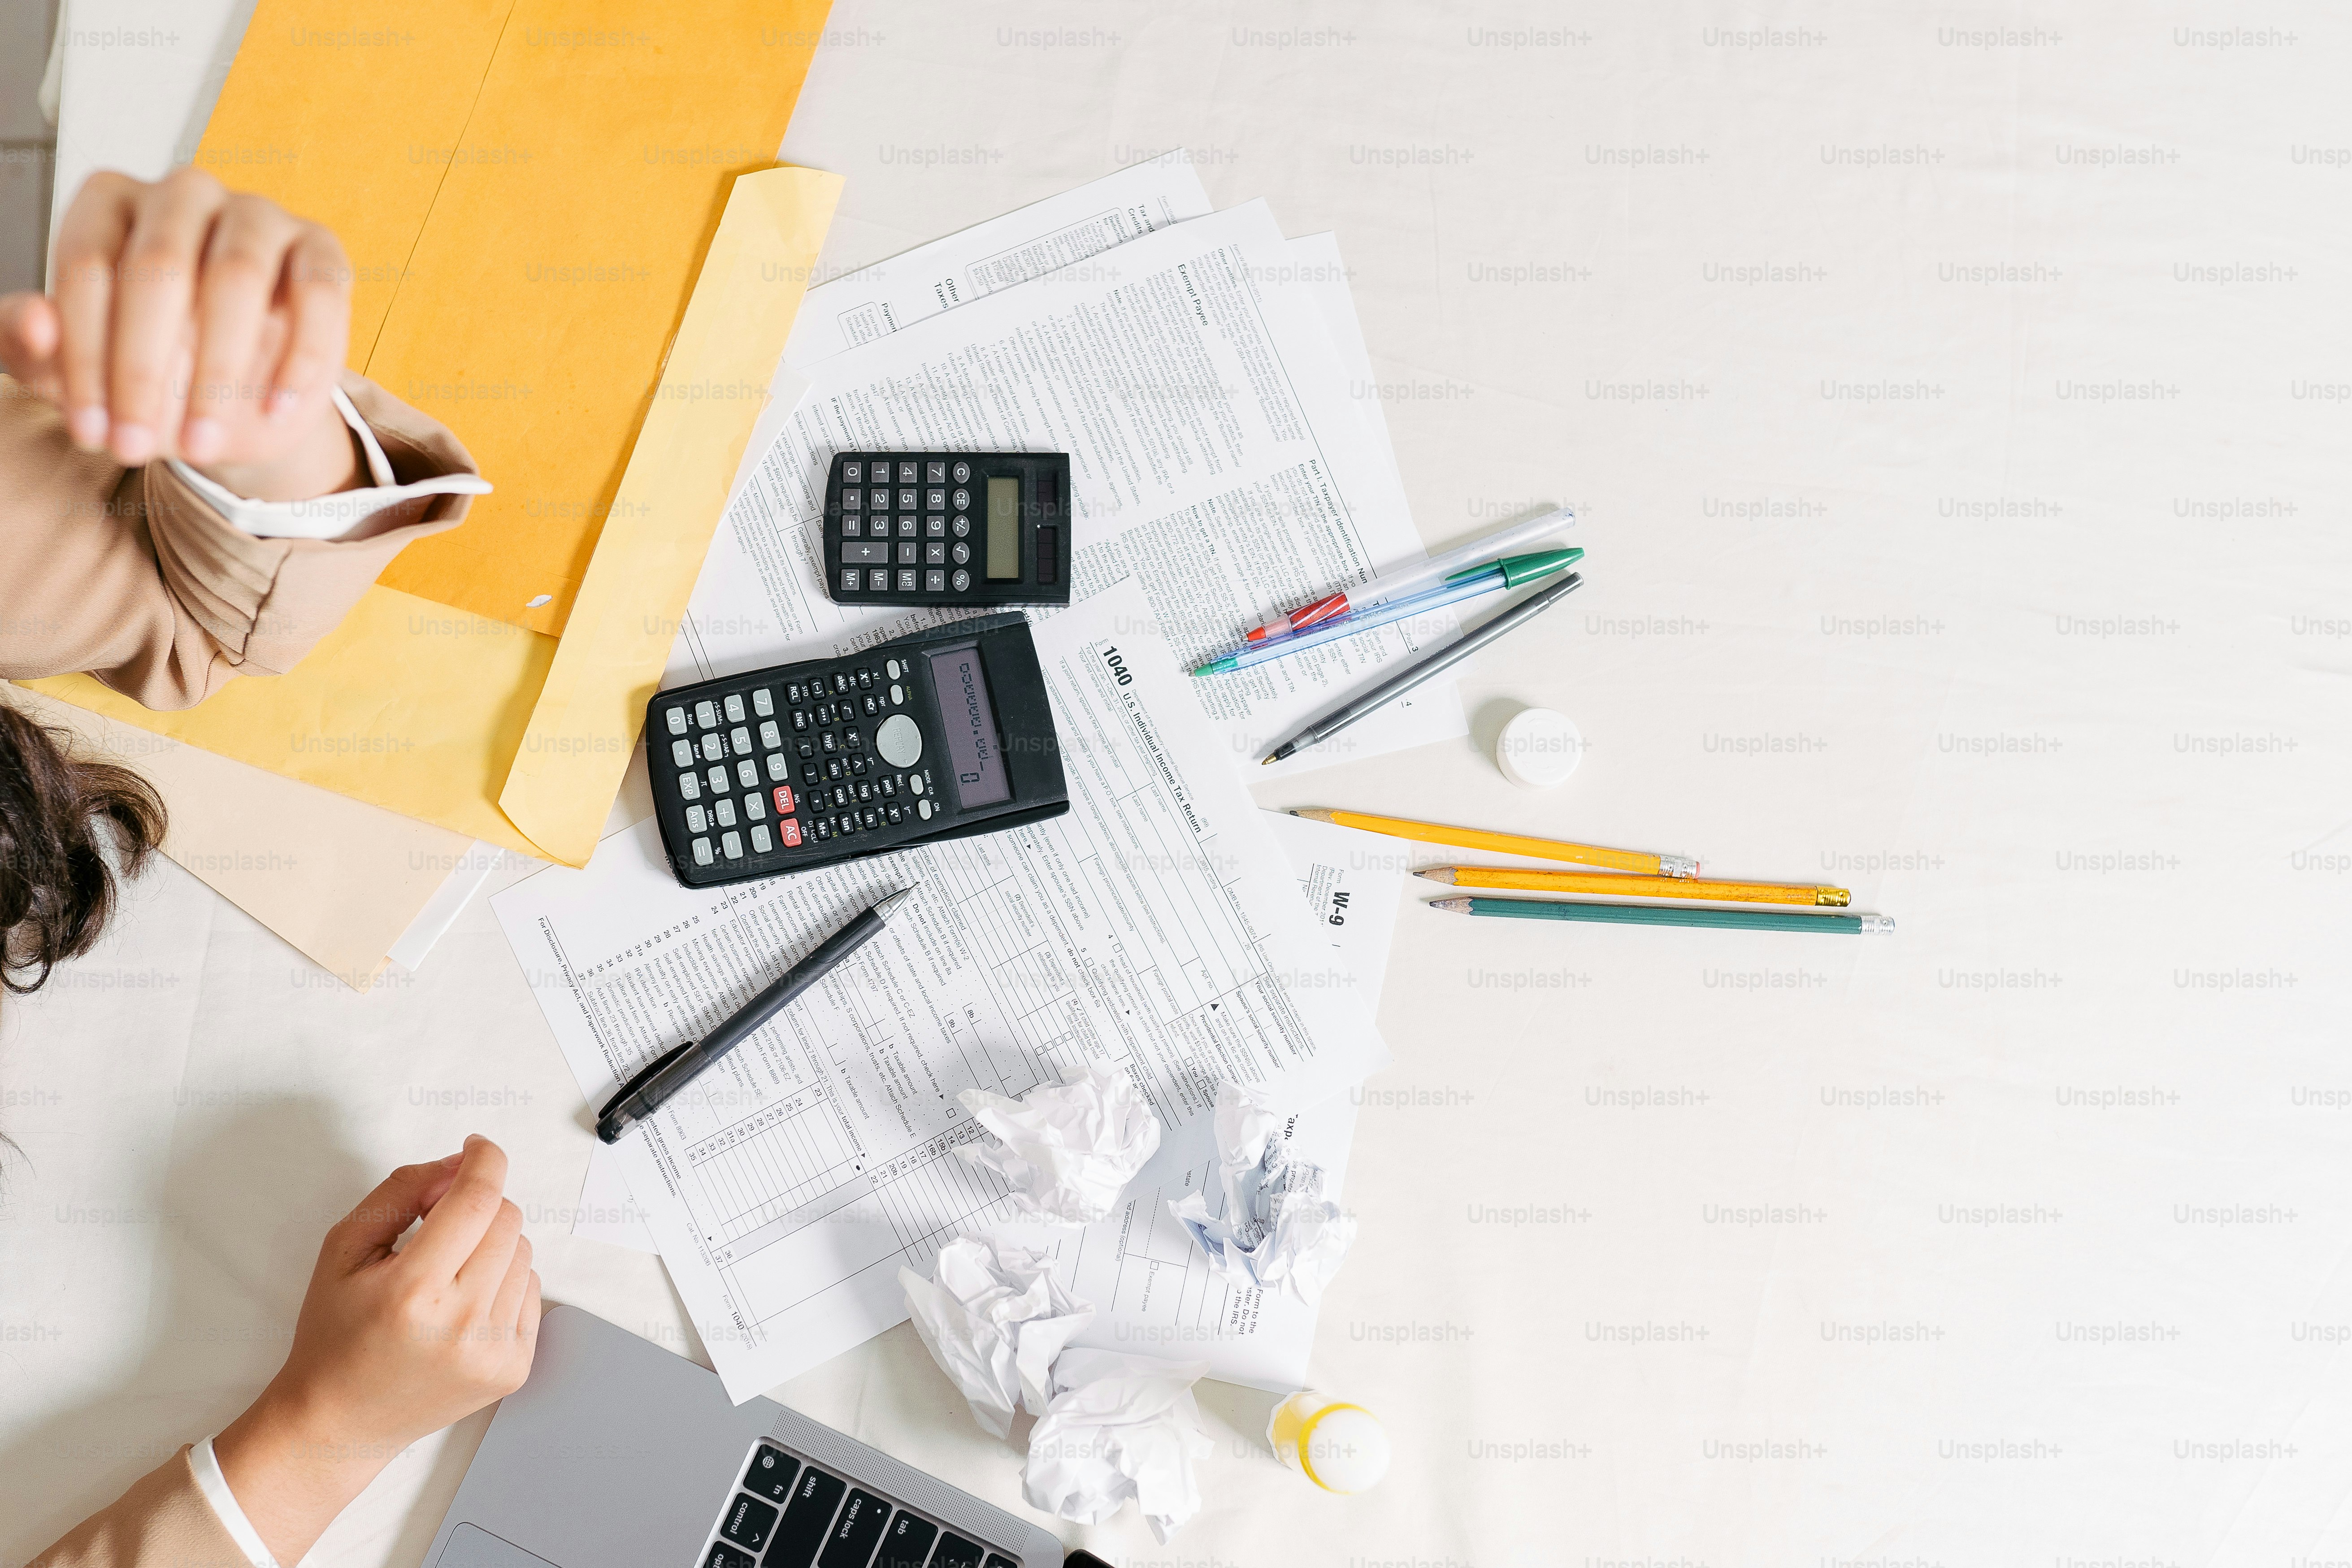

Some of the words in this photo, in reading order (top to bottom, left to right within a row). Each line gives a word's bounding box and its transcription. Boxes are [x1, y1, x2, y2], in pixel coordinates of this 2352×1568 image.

[1128, 208, 1143, 234] Credits
[1138, 204, 1147, 217] Tax
[1145, 219, 1156, 232] and
[1218, 248, 1228, 265] Other
[934, 282, 949, 308] Taxes
[946, 278, 960, 302] Other
[1177, 264, 1197, 298] Exempt
[1193, 299, 1208, 326] Payee
[848, 467, 858, 476] 0
[903, 467, 912, 476] 4
[932, 467, 942, 476] 7
[875, 494, 885, 503] 2
[902, 494, 912, 503] 5
[931, 494, 941, 503] 8
[957, 493, 965, 505] CE
[1309, 459, 1320, 476] Part
[1320, 482, 1338, 517] Taxpayer
[1335, 518, 1360, 567] Identification
[875, 521, 885, 530] 3
[902, 521, 912, 530] 6
[931, 521, 941, 530] 9
[846, 573, 855, 586] M+
[956, 574, 965, 585] %
[1406, 633, 1414, 646] Page
[1103, 646, 1133, 686] 1040
[1078, 650, 1087, 663] Your
[1084, 663, 1092, 673] first
[1089, 673, 1099, 688] name
[1097, 688, 1106, 698] and
[1103, 698, 1113, 712] initial
[790, 686, 798, 700] RCL
[729, 704, 739, 712] 4
[756, 697, 768, 705] 7
[669, 716, 681, 725] 0
[795, 712, 803, 727] ENG
[734, 736, 746, 745] 5
[764, 730, 775, 739] 8
[825, 734, 833, 749] hyp
[893, 728, 906, 754] REPLAY
[705, 743, 716, 751] 2
[770, 763, 782, 771] 9
[1123, 692, 1135, 712] U.S.
[1133, 712, 1159, 753] Individual
[1155, 753, 1175, 785] Income
[1174, 785, 1185, 803] Tax
[1182, 803, 1201, 833] Return
[712, 776, 723, 784] 3
[741, 769, 752, 778] 6
[682, 777, 693, 795] EXP
[778, 790, 789, 810] DEL
[1150, 786, 1159, 798] Last
[1156, 798, 1167, 812] name
[934, 803, 940, 812] ON
[690, 811, 699, 828] Ans
[867, 814, 873, 823] ln
[785, 825, 797, 841] AC
[818, 823, 826, 835] M+
[1336, 869, 1344, 884] Form
[1227, 887, 1237, 901] OMB
[1240, 912, 1257, 939] 1545-0074
[1328, 892, 1350, 926] W-9
[538, 917, 546, 928] For
[544, 929, 562, 964] Disclosure,
[561, 964, 575, 987] Privacy
[572, 989, 581, 1002] Act,
[579, 1002, 589, 1014] and
[586, 1014, 605, 1049] Paperwork
[602, 1049, 623, 1082] Reduction
[1255, 980, 1264, 994] Your
[1262, 995, 1274, 1012] social
[1271, 1012, 1285, 1034] security
[1283, 1034, 1297, 1055] number
[1263, 976, 1271, 989] See
[1269, 989, 1285, 1015] separate
[1284, 1014, 1304, 1051] instructions.
[1092, 968, 1108, 996] Qualifying
[1106, 996, 1123, 1023] widow(er)
[1120, 1023, 1129, 1035] with
[1127, 1036, 1145, 1066] dependent
[1142, 1066, 1154, 1080] child
[1130, 1064, 1141, 1082] Boxes
[1139, 1082, 1155, 1106] checked
[1202, 1089, 1214, 1108] Spouse
[686, 1223, 694, 1234] Cat.
[698, 1246, 711, 1266] 11320B
[1145, 1271, 1155, 1293] Exempt
[1254, 1289, 1263, 1309] Form
[722, 1294, 732, 1309] Form
[731, 1311, 745, 1330] 1040
[740, 1333, 753, 1350] (2015)
[1249, 1321, 1257, 1333] the
[773, 1485, 783, 1495] fn
[803, 1477, 816, 1498] shift
[850, 1499, 862, 1520] caps
[730, 1503, 748, 1535] control
[839, 1520, 854, 1538] lock
[898, 1520, 909, 1535] tab
